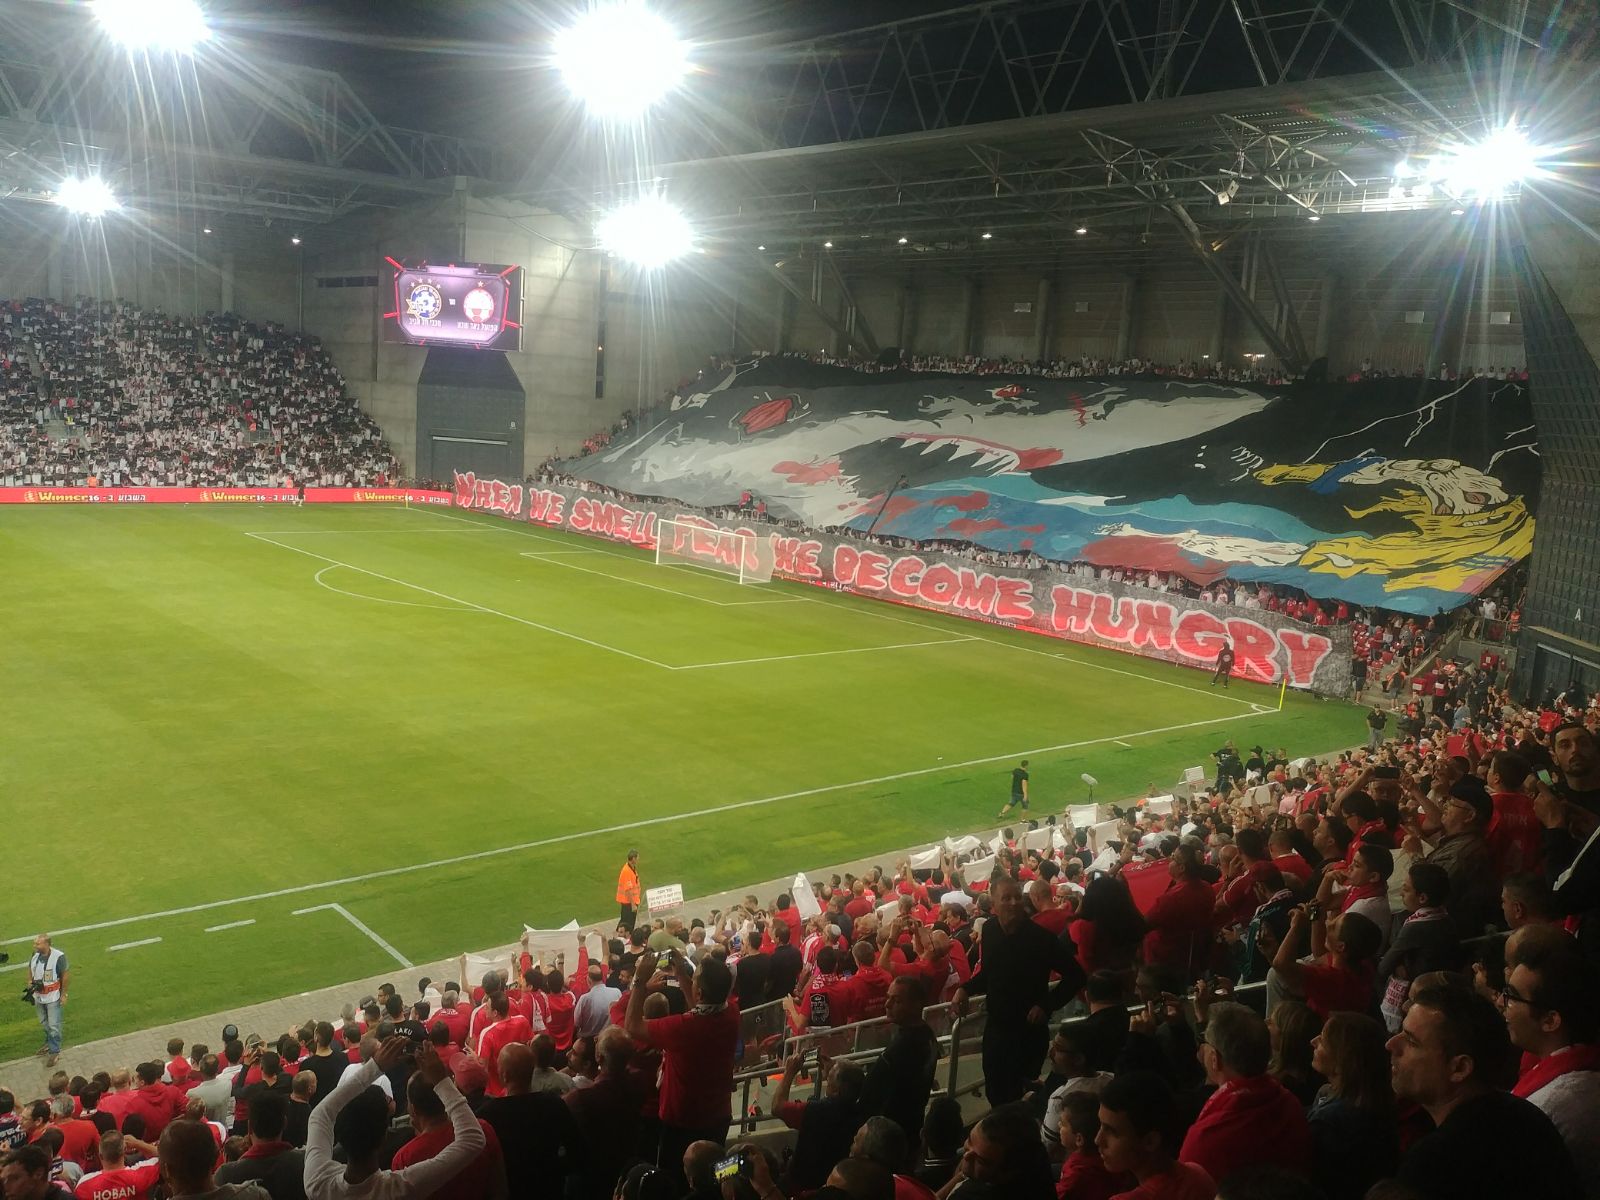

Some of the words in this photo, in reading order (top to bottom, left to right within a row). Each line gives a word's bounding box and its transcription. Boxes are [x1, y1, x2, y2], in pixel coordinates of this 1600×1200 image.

[454, 468, 523, 514] WHEN
[529, 488, 566, 524] WE
[569, 497, 659, 543] SMELL
[673, 514, 760, 571] FEAR
[769, 533, 823, 578] WE
[833, 544, 1034, 619] BECOME
[1041, 584, 1333, 688] HUNGRY
[1574, 608, 1581, 621] A
[93, 1185, 136, 1200] HOBAN
